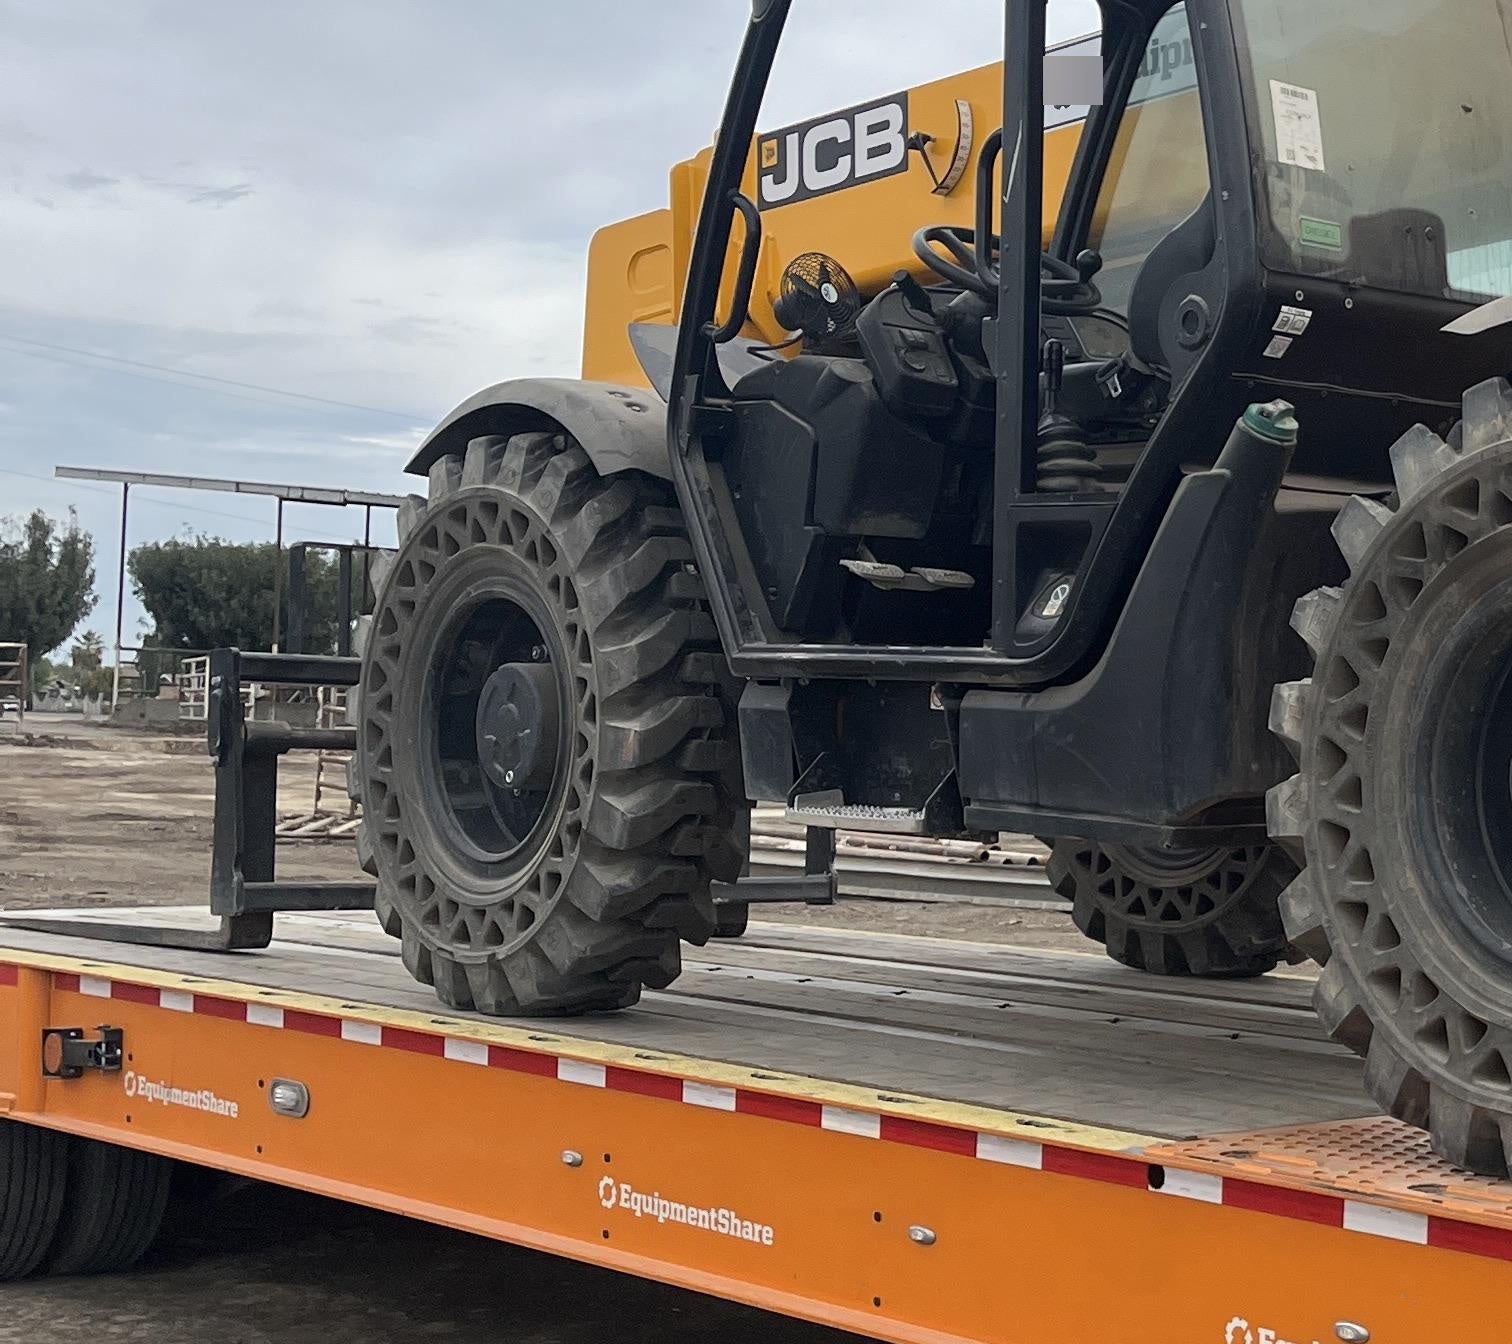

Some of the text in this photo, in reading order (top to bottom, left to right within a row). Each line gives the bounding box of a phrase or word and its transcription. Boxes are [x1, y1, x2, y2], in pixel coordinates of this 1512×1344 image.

[761, 102, 905, 203] JCB
[137, 1075, 239, 1118] EquipmentShare
[619, 1183, 774, 1246] EquipmentShare
